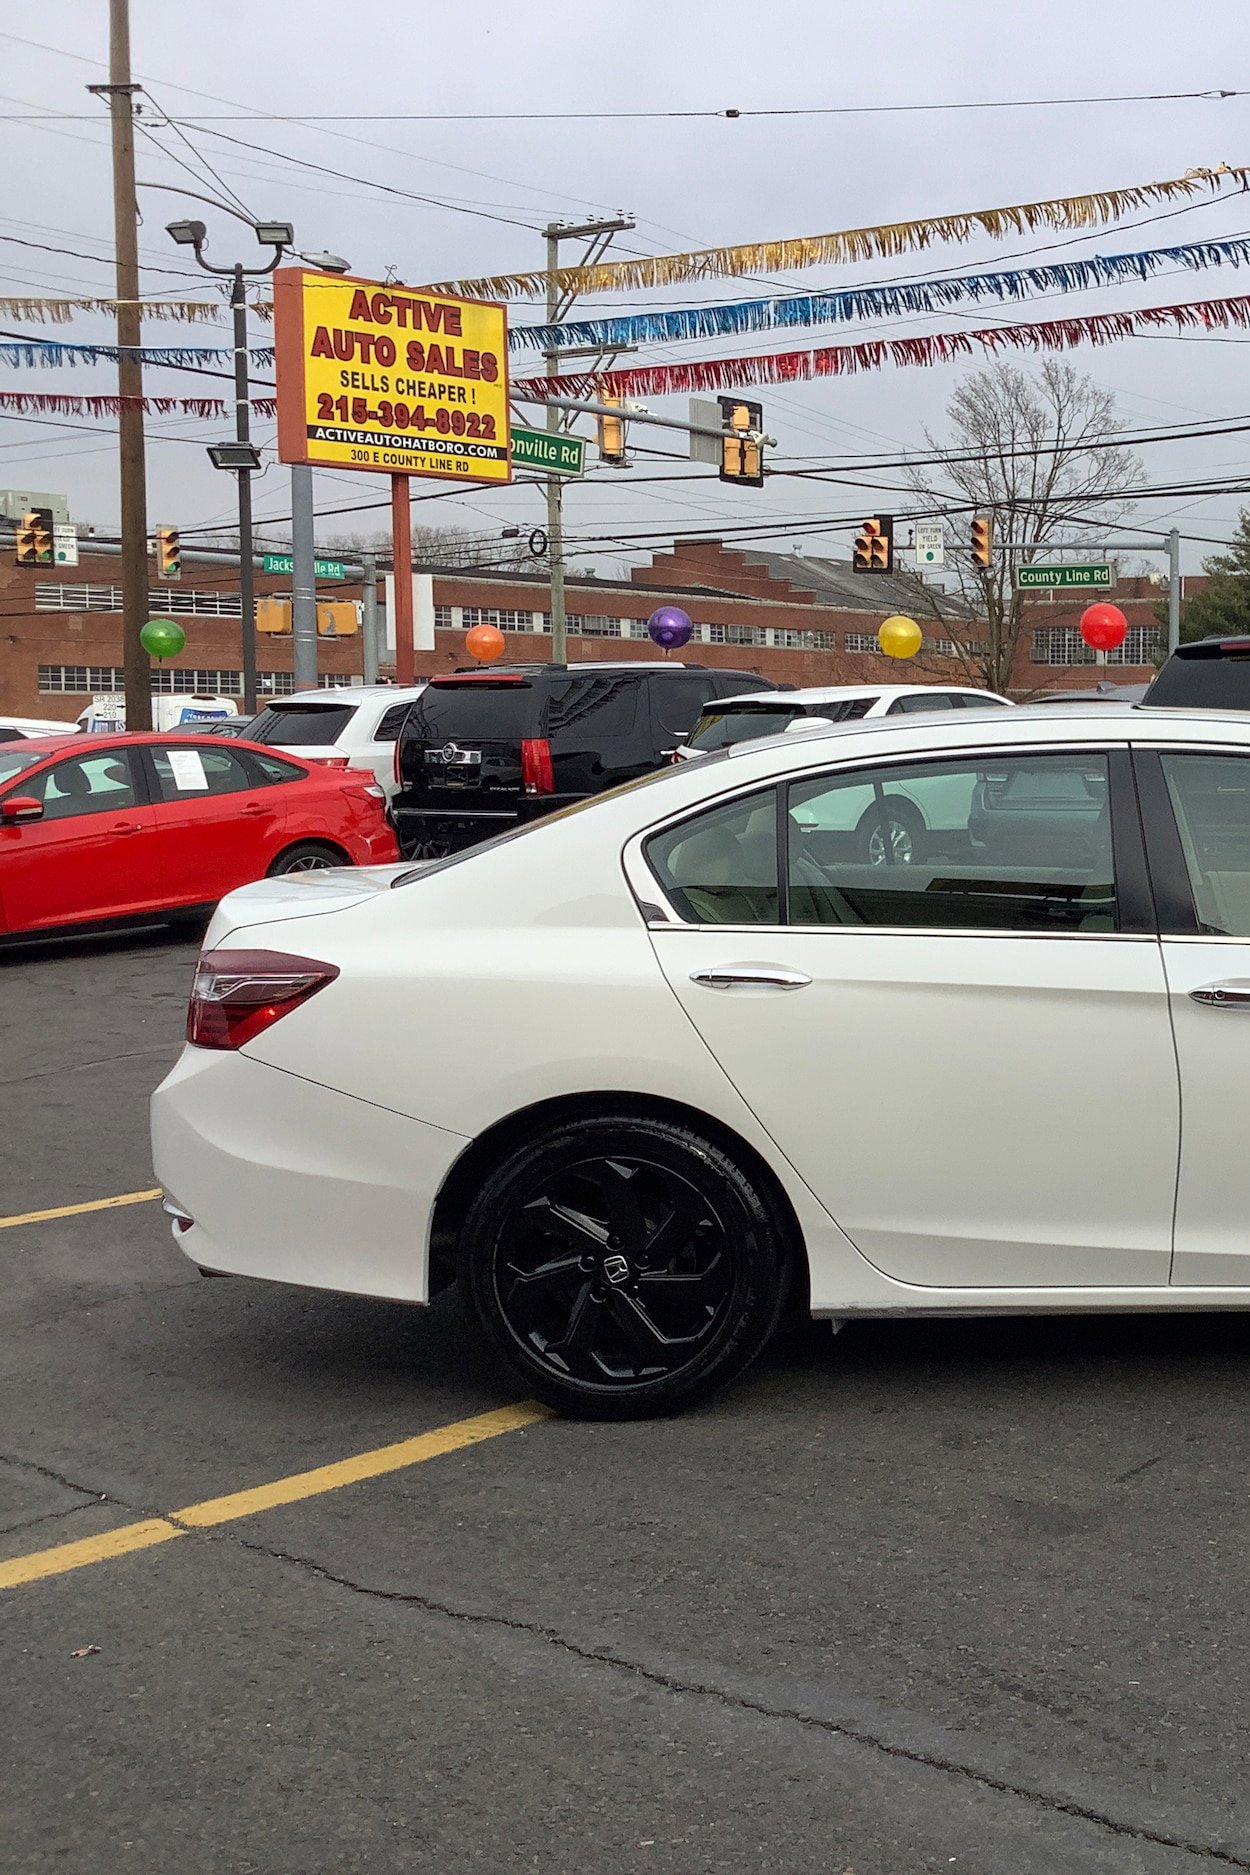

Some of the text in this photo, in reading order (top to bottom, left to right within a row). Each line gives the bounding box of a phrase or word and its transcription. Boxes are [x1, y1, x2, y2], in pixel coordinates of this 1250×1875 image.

[349, 289, 462, 337] ACTIVE
[311, 326, 498, 382] AUTO SALES
[340, 370, 389, 393] SELLS
[396, 378, 467, 404] CHEAPER
[317, 392, 496, 440] 215-394-8922
[315, 427, 498, 459] ACTIVEAUTOHATBORO.COM
[510, 438, 579, 465] onville Rd
[351, 449, 469, 472] 300 E COUNTY LINE RD
[922, 535, 938, 543] YIELD
[327, 563, 340, 576] Rd
[1020, 568, 1109, 585] County Line Rd
[94, 695, 105, 703] SR
